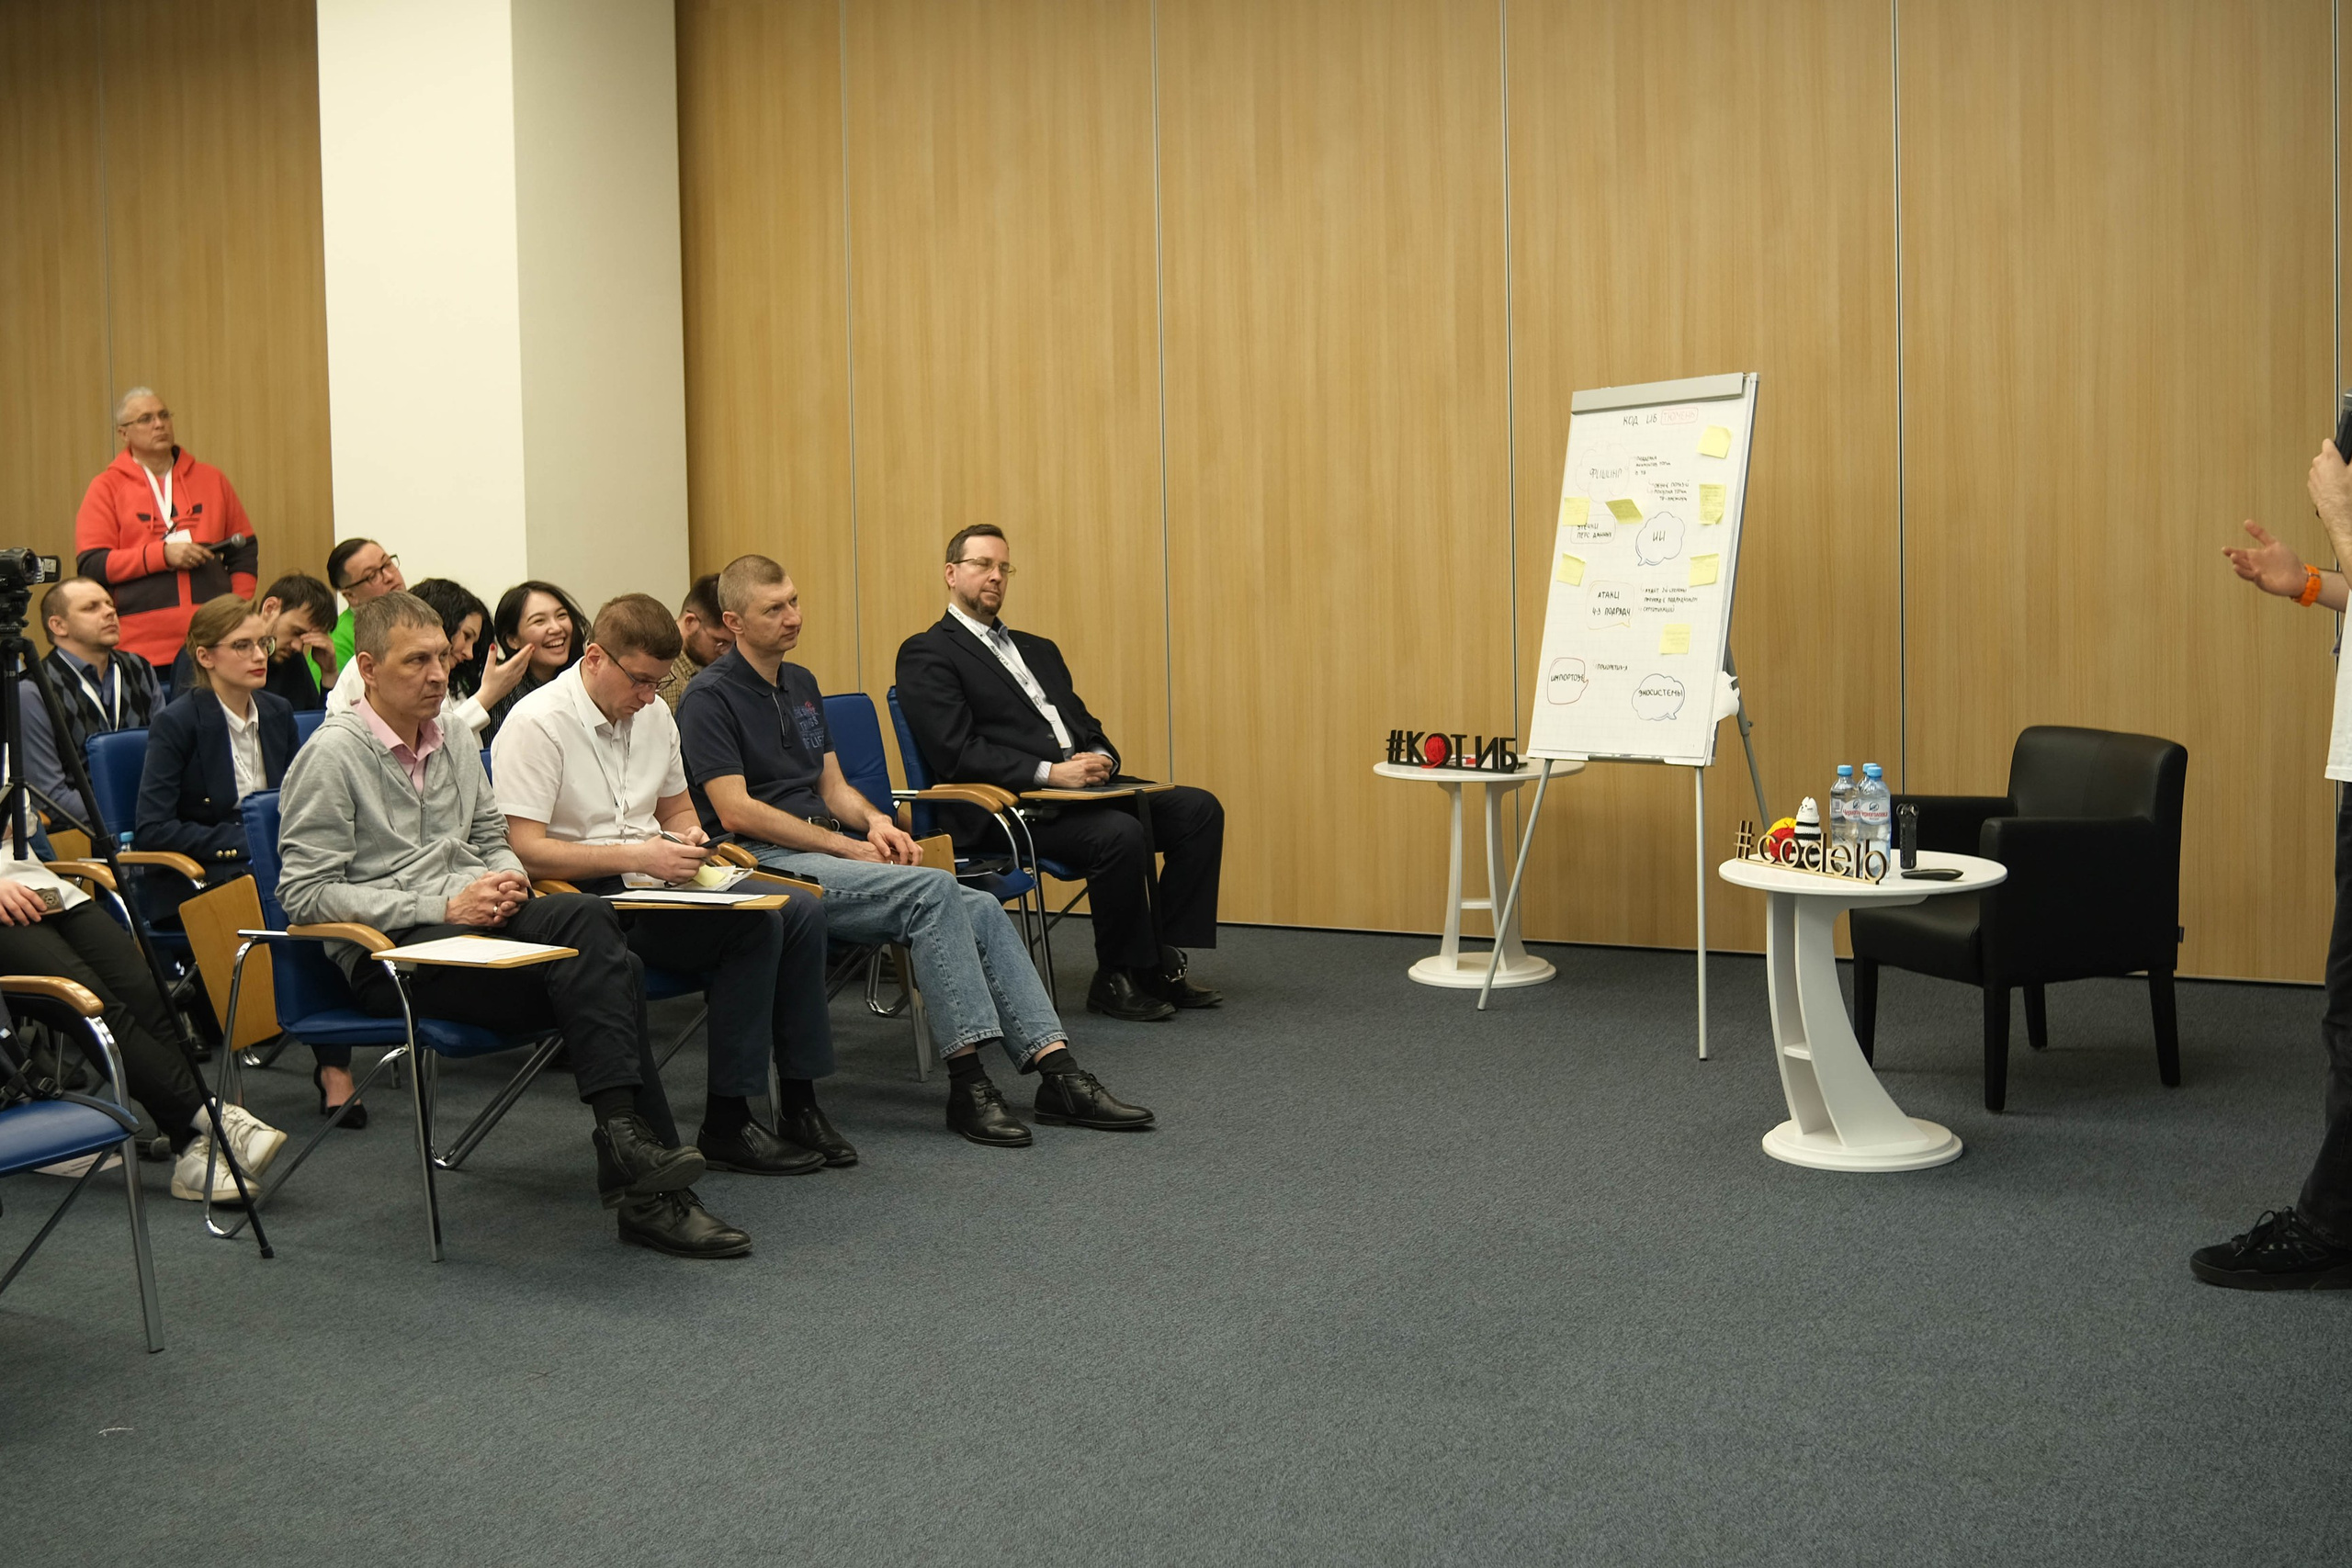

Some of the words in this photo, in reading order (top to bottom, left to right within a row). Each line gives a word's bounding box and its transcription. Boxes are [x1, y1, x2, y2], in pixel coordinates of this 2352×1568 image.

[1623, 415, 1639, 426] КОД
[1663, 411, 1695, 423] ТЮМЕНЬ
[1589, 467, 1623, 479] ФИШИНГ
[1598, 591, 1620, 600] АТАКИ
[1638, 688, 1683, 697] ЭКОСИСТЕМЫ
